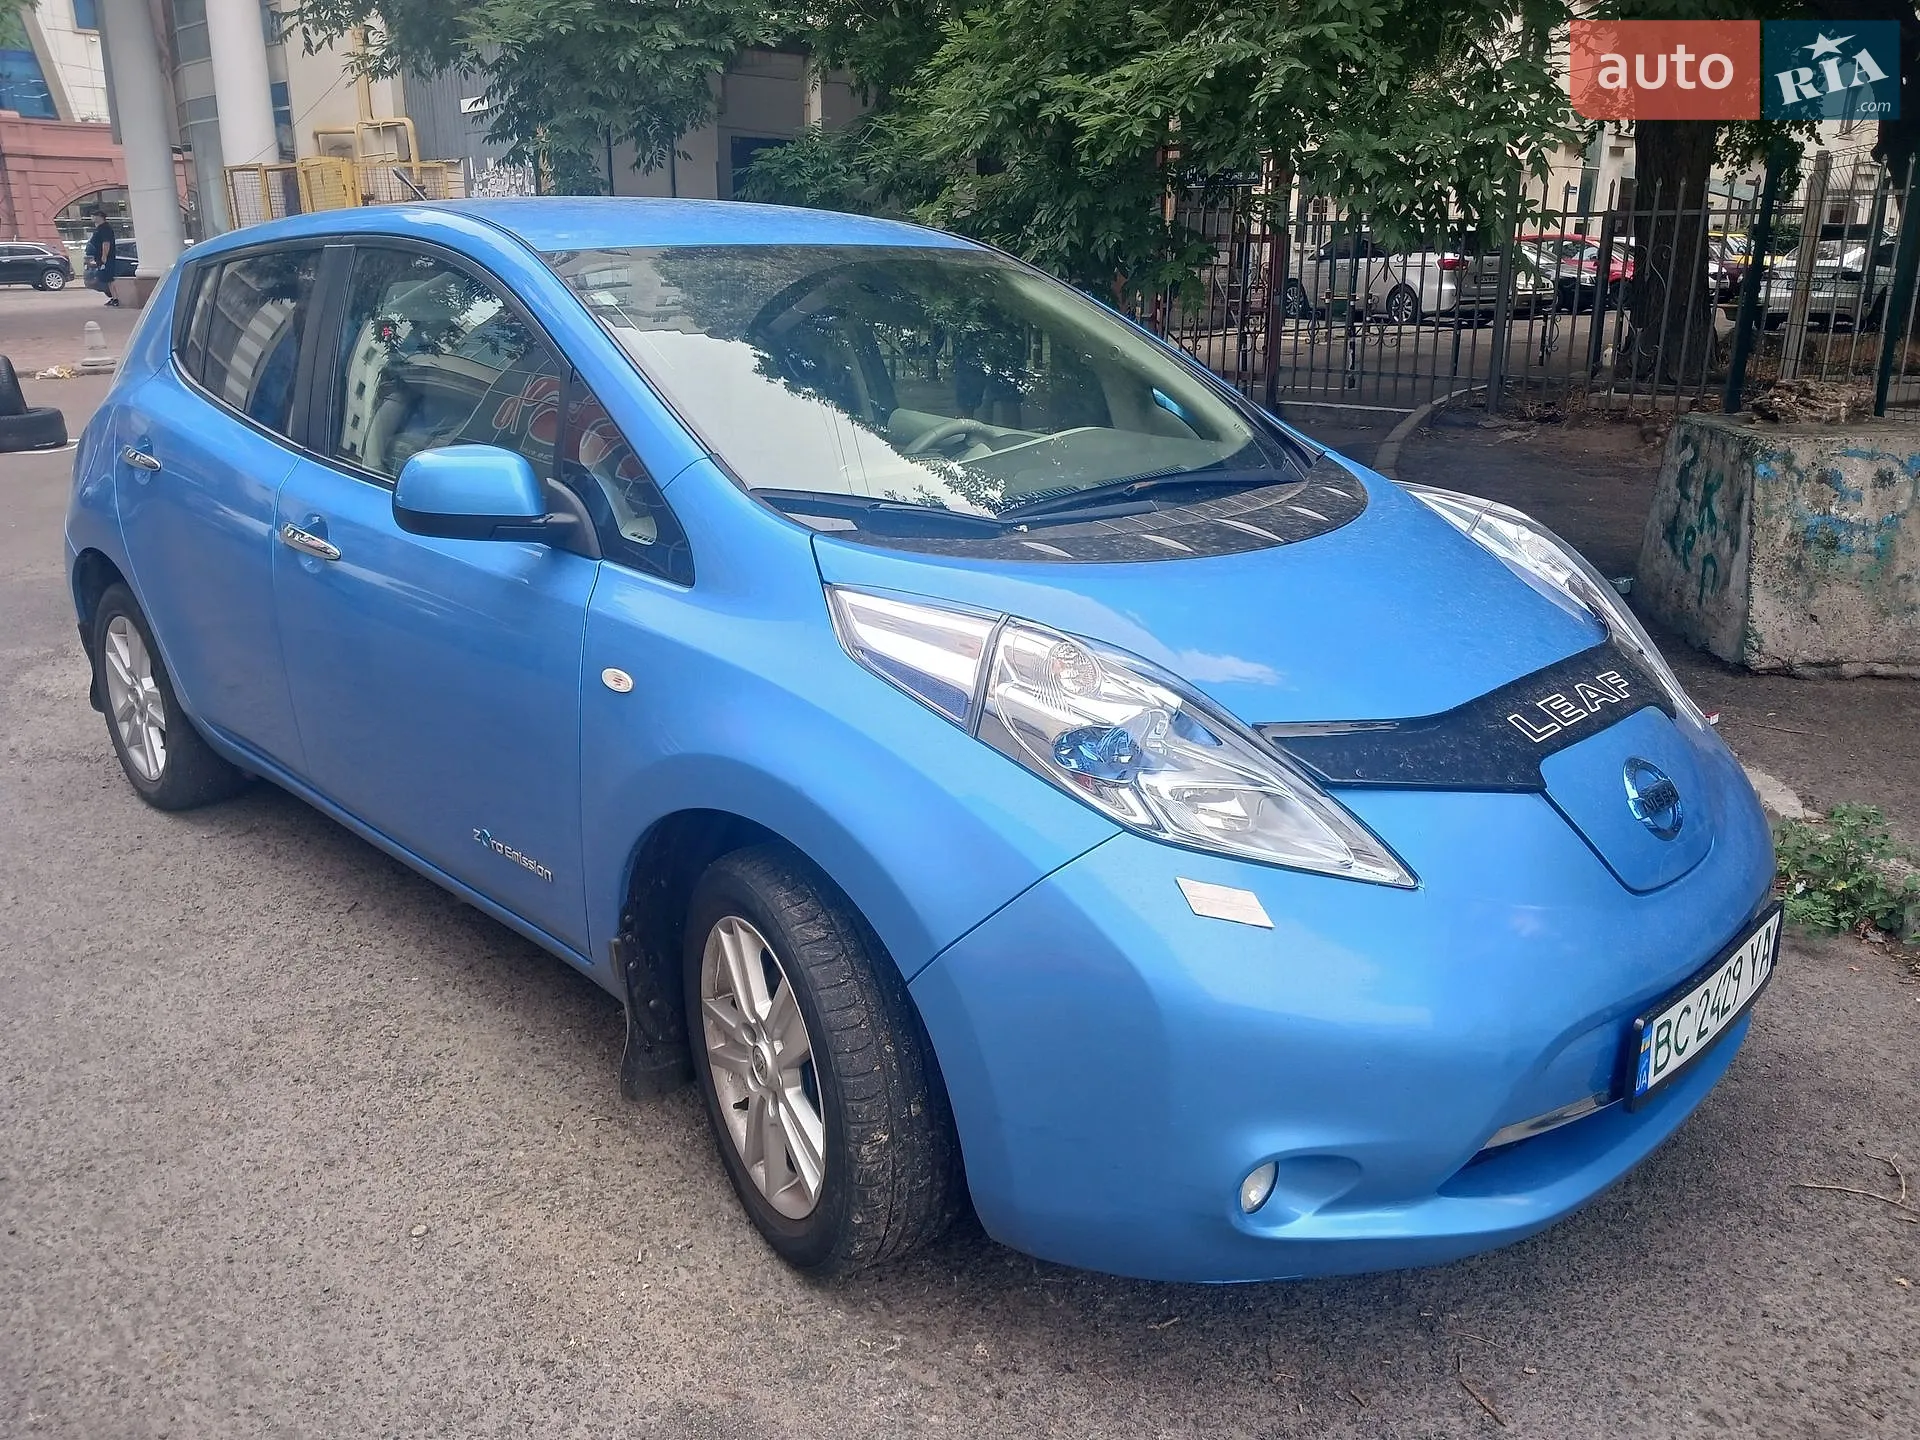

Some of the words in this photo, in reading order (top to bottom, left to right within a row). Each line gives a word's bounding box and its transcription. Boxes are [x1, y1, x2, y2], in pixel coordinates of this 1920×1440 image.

[1507, 670, 1631, 743] LEAF
[504, 846, 553, 883] Emission
[1653, 1004, 1691, 1077] BC
[1696, 955, 1743, 1042] 2429
[1750, 926, 1771, 985] YA
